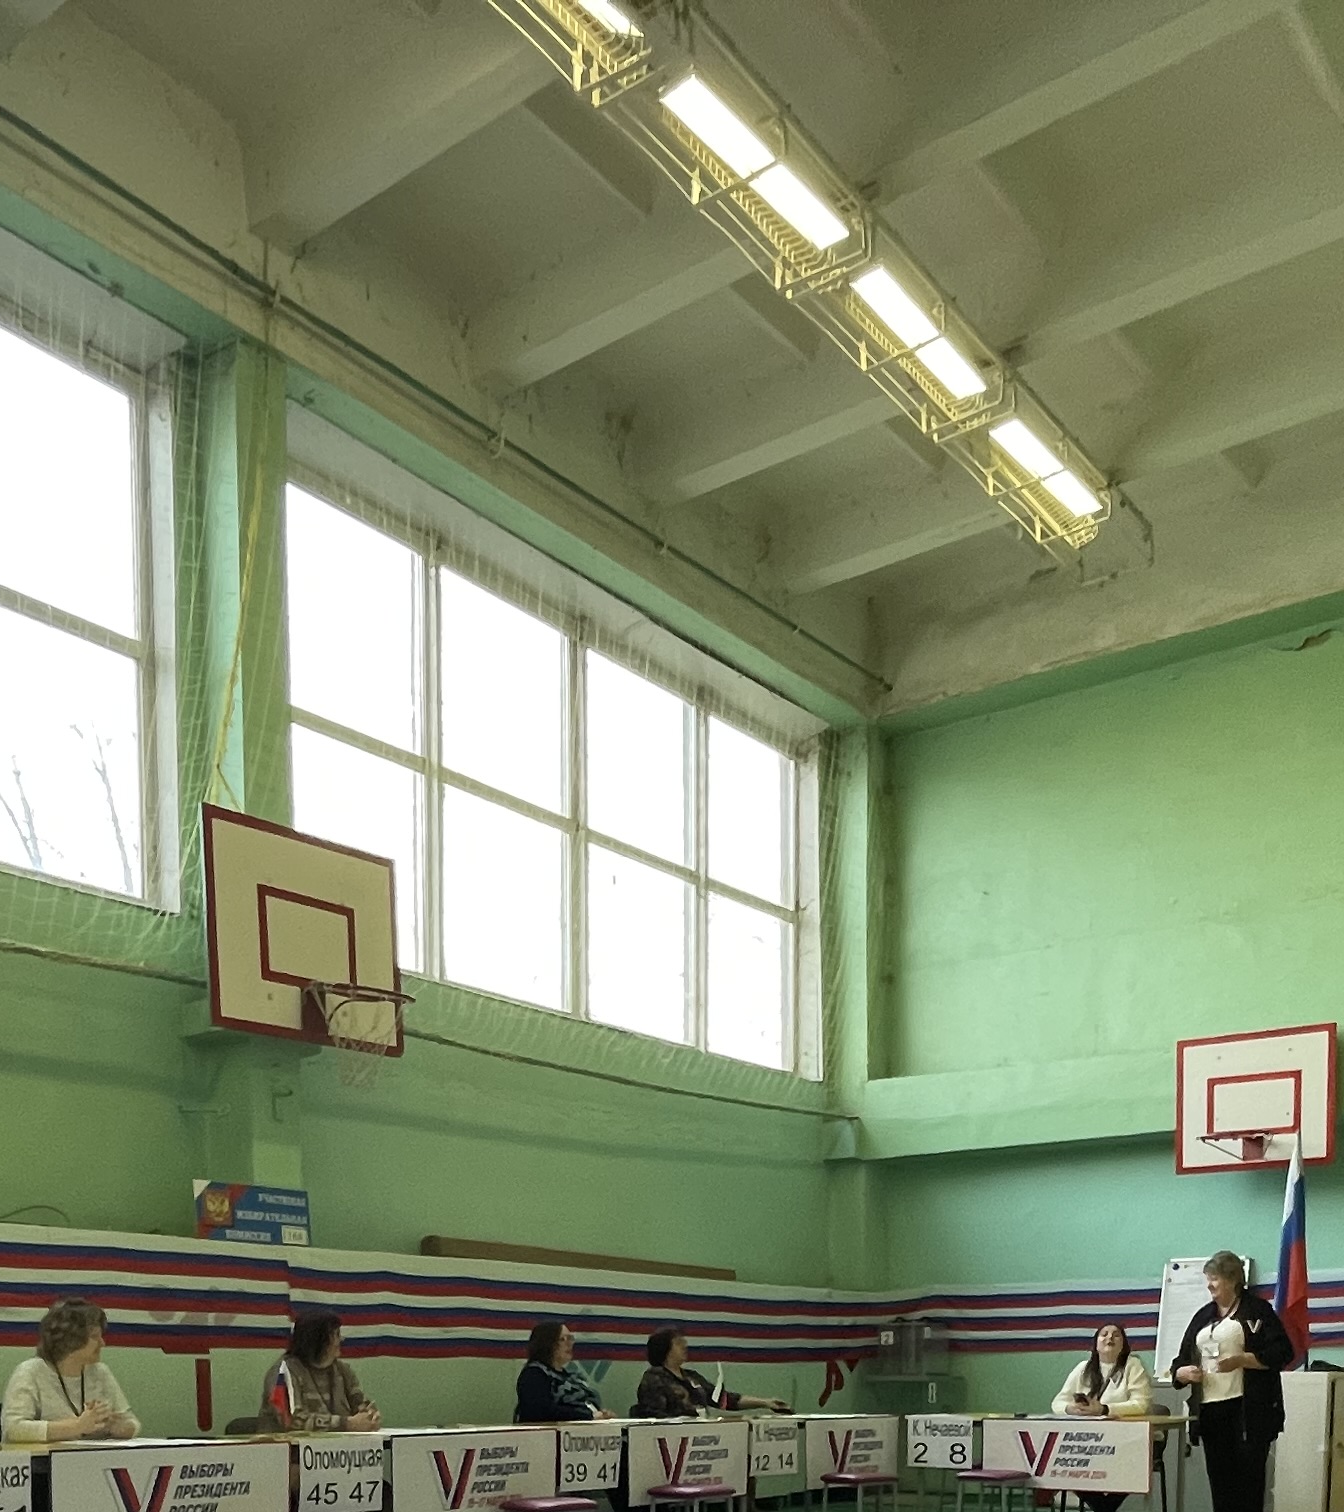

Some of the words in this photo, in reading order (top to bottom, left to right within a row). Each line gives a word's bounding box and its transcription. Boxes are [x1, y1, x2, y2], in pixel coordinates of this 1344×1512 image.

[302, 1443, 383, 1475] Оломоуцкая
[754, 1454, 770, 1471] 12
[778, 1452, 794, 1469] 14
[913, 1442, 928, 1464] 2
[949, 1442, 967, 1465] 8
[179, 1463, 235, 1480] ВЫБОРЫ
[564, 1462, 588, 1483] 39
[596, 1461, 618, 1482] 41
[173, 1480, 251, 1500] ПРЕЗИДЕНТА
[306, 1482, 339, 1506] 45
[348, 1480, 380, 1504] 47
